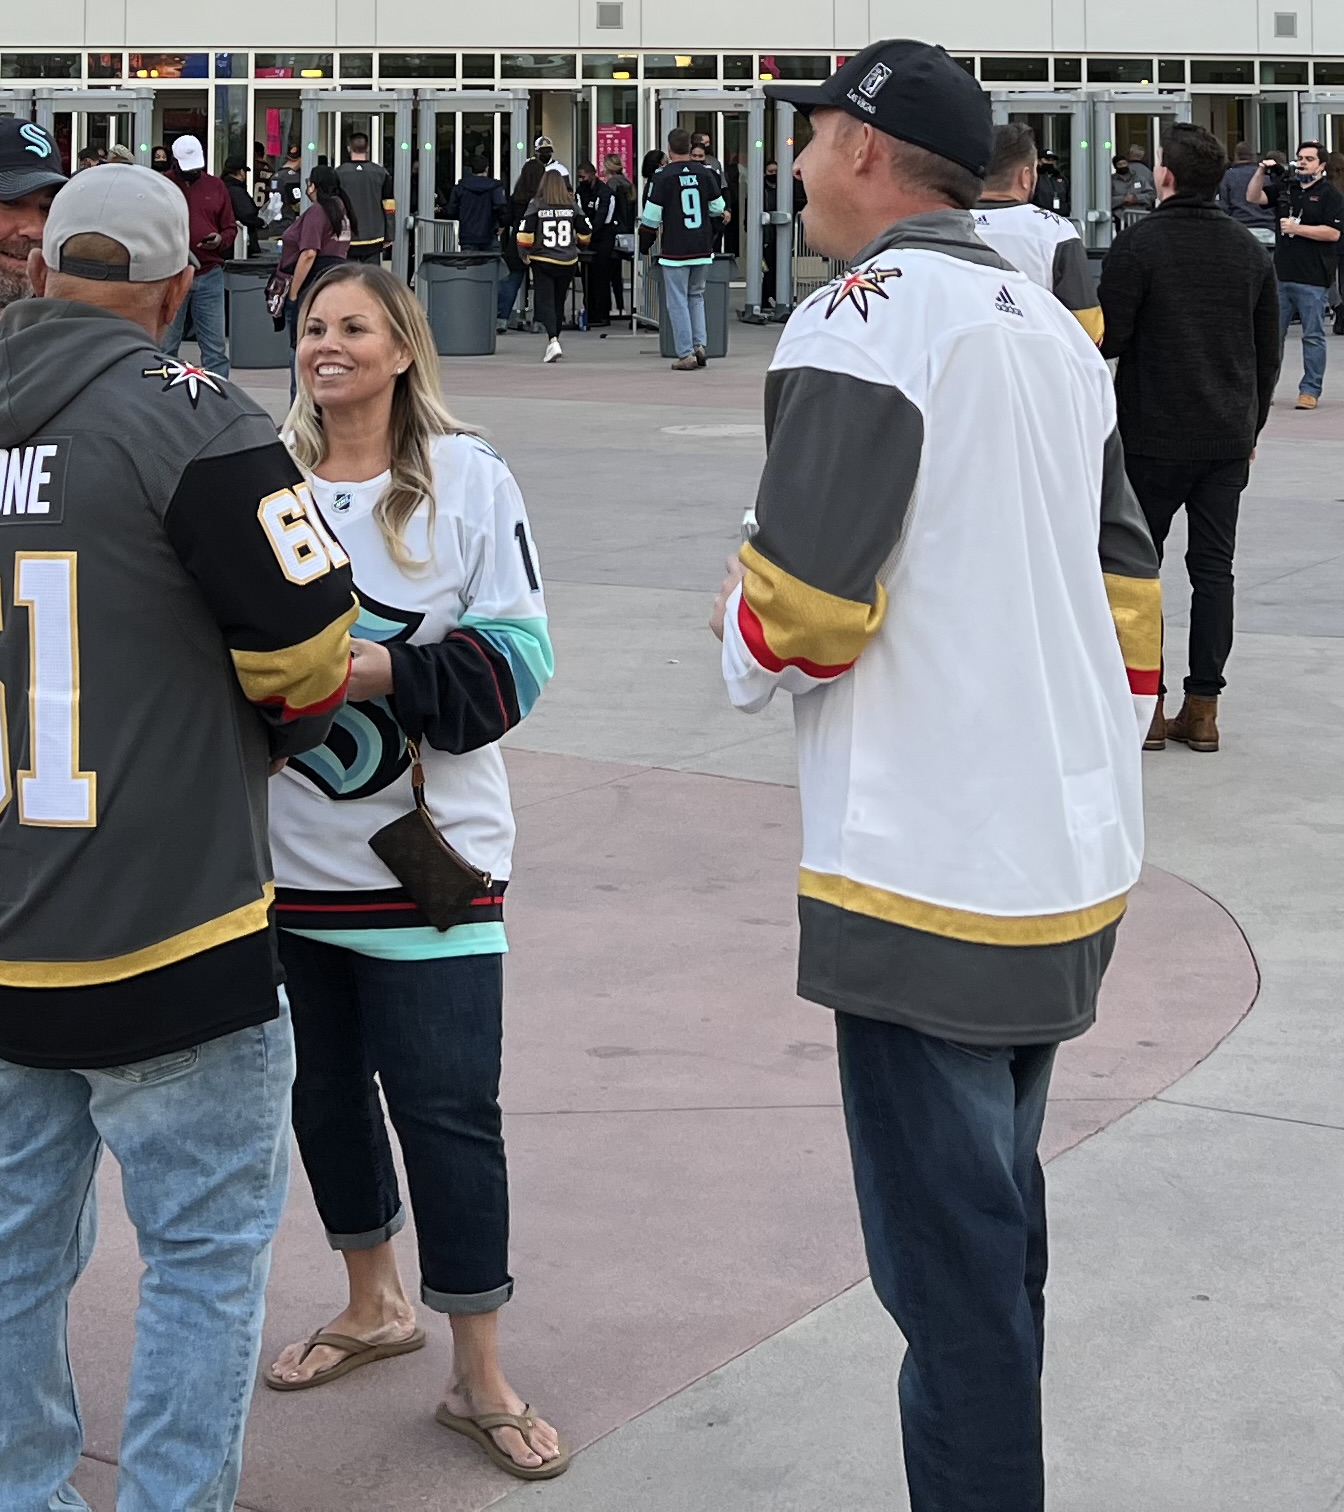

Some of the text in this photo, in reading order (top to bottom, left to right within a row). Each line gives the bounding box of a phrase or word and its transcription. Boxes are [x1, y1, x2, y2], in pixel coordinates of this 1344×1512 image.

[681, 188, 702, 230] 9
[542, 220, 572, 248] 58
[257, 481, 349, 586] 61
